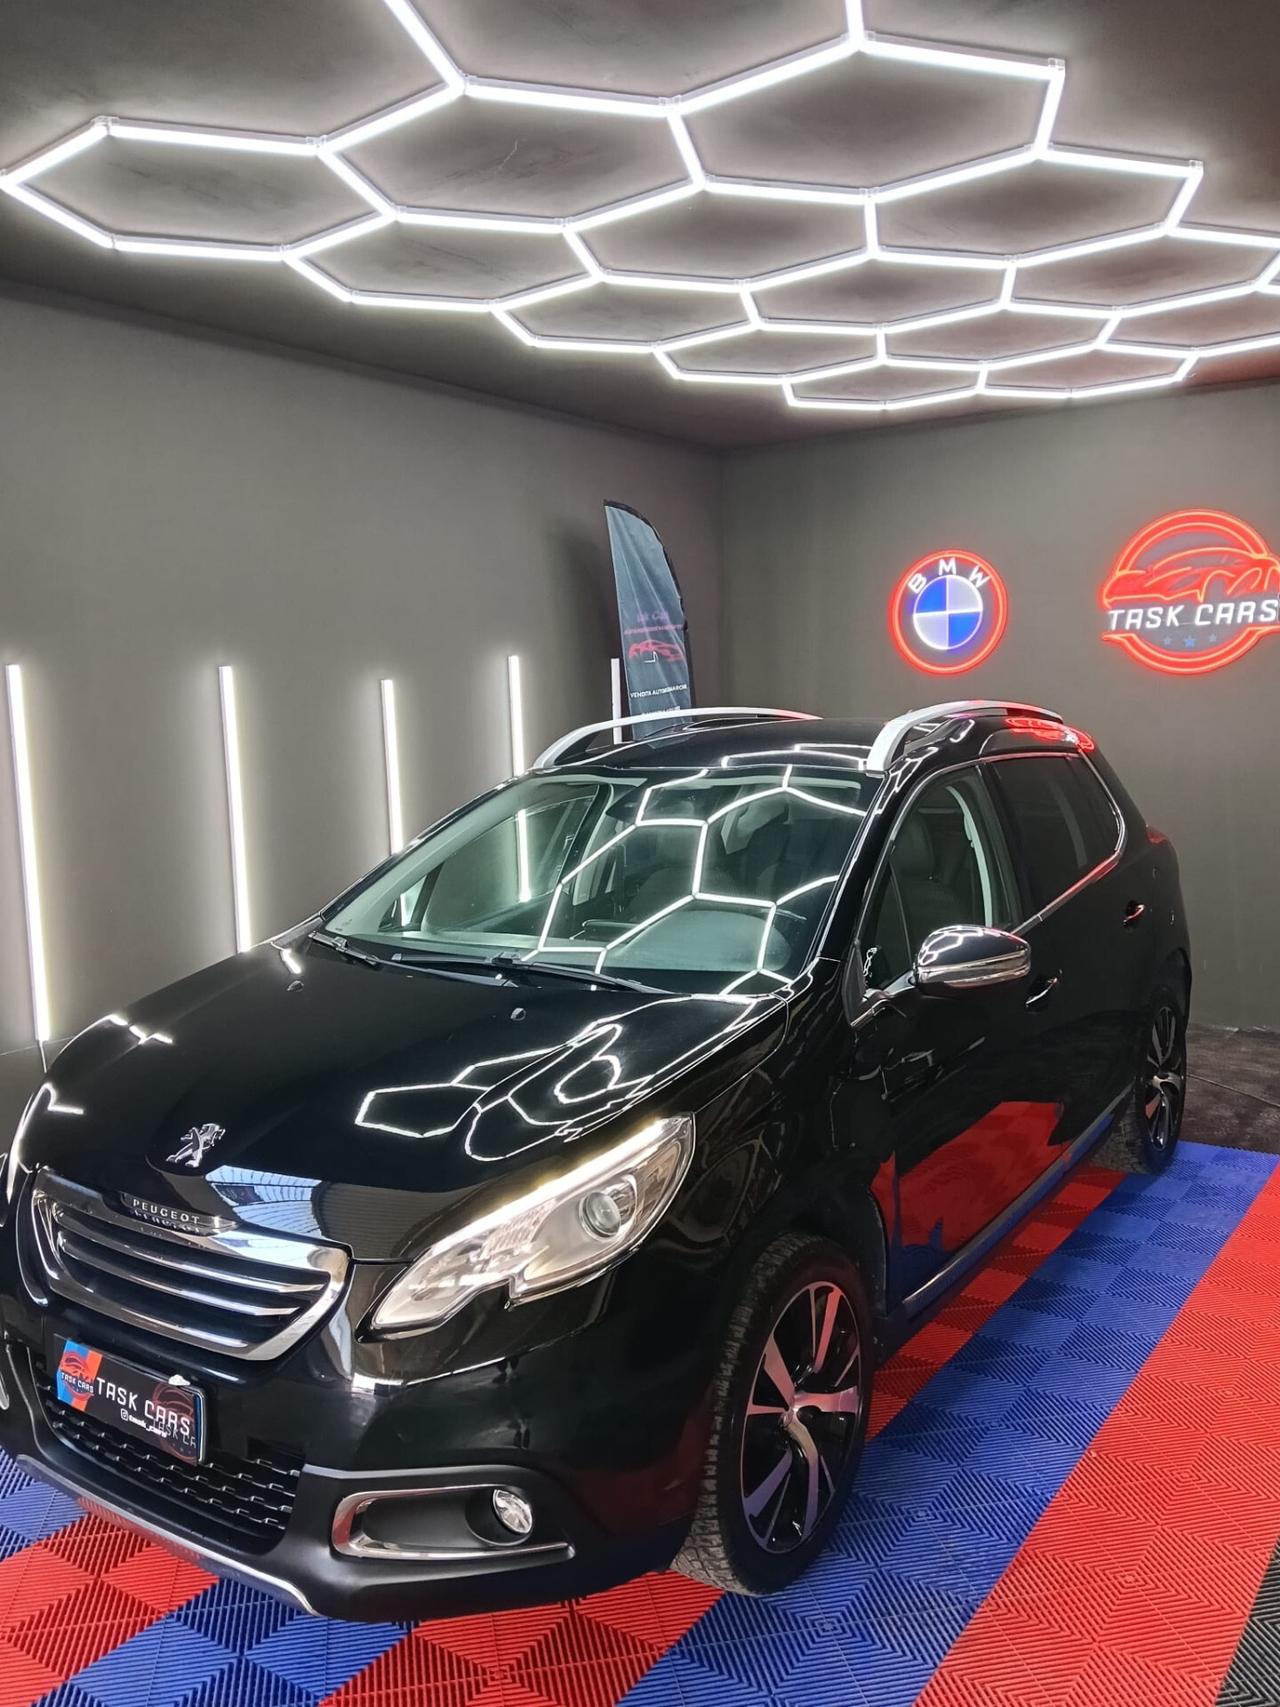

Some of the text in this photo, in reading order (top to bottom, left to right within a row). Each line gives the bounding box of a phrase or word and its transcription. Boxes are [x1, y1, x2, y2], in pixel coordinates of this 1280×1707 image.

[907, 557, 991, 594] BMW
[1107, 599, 1279, 631] TASK CARS
[132, 1198, 200, 1224] PEUGEOT
[61, 1372, 77, 1385] TASK
[96, 1376, 191, 1437] TASK CARS
